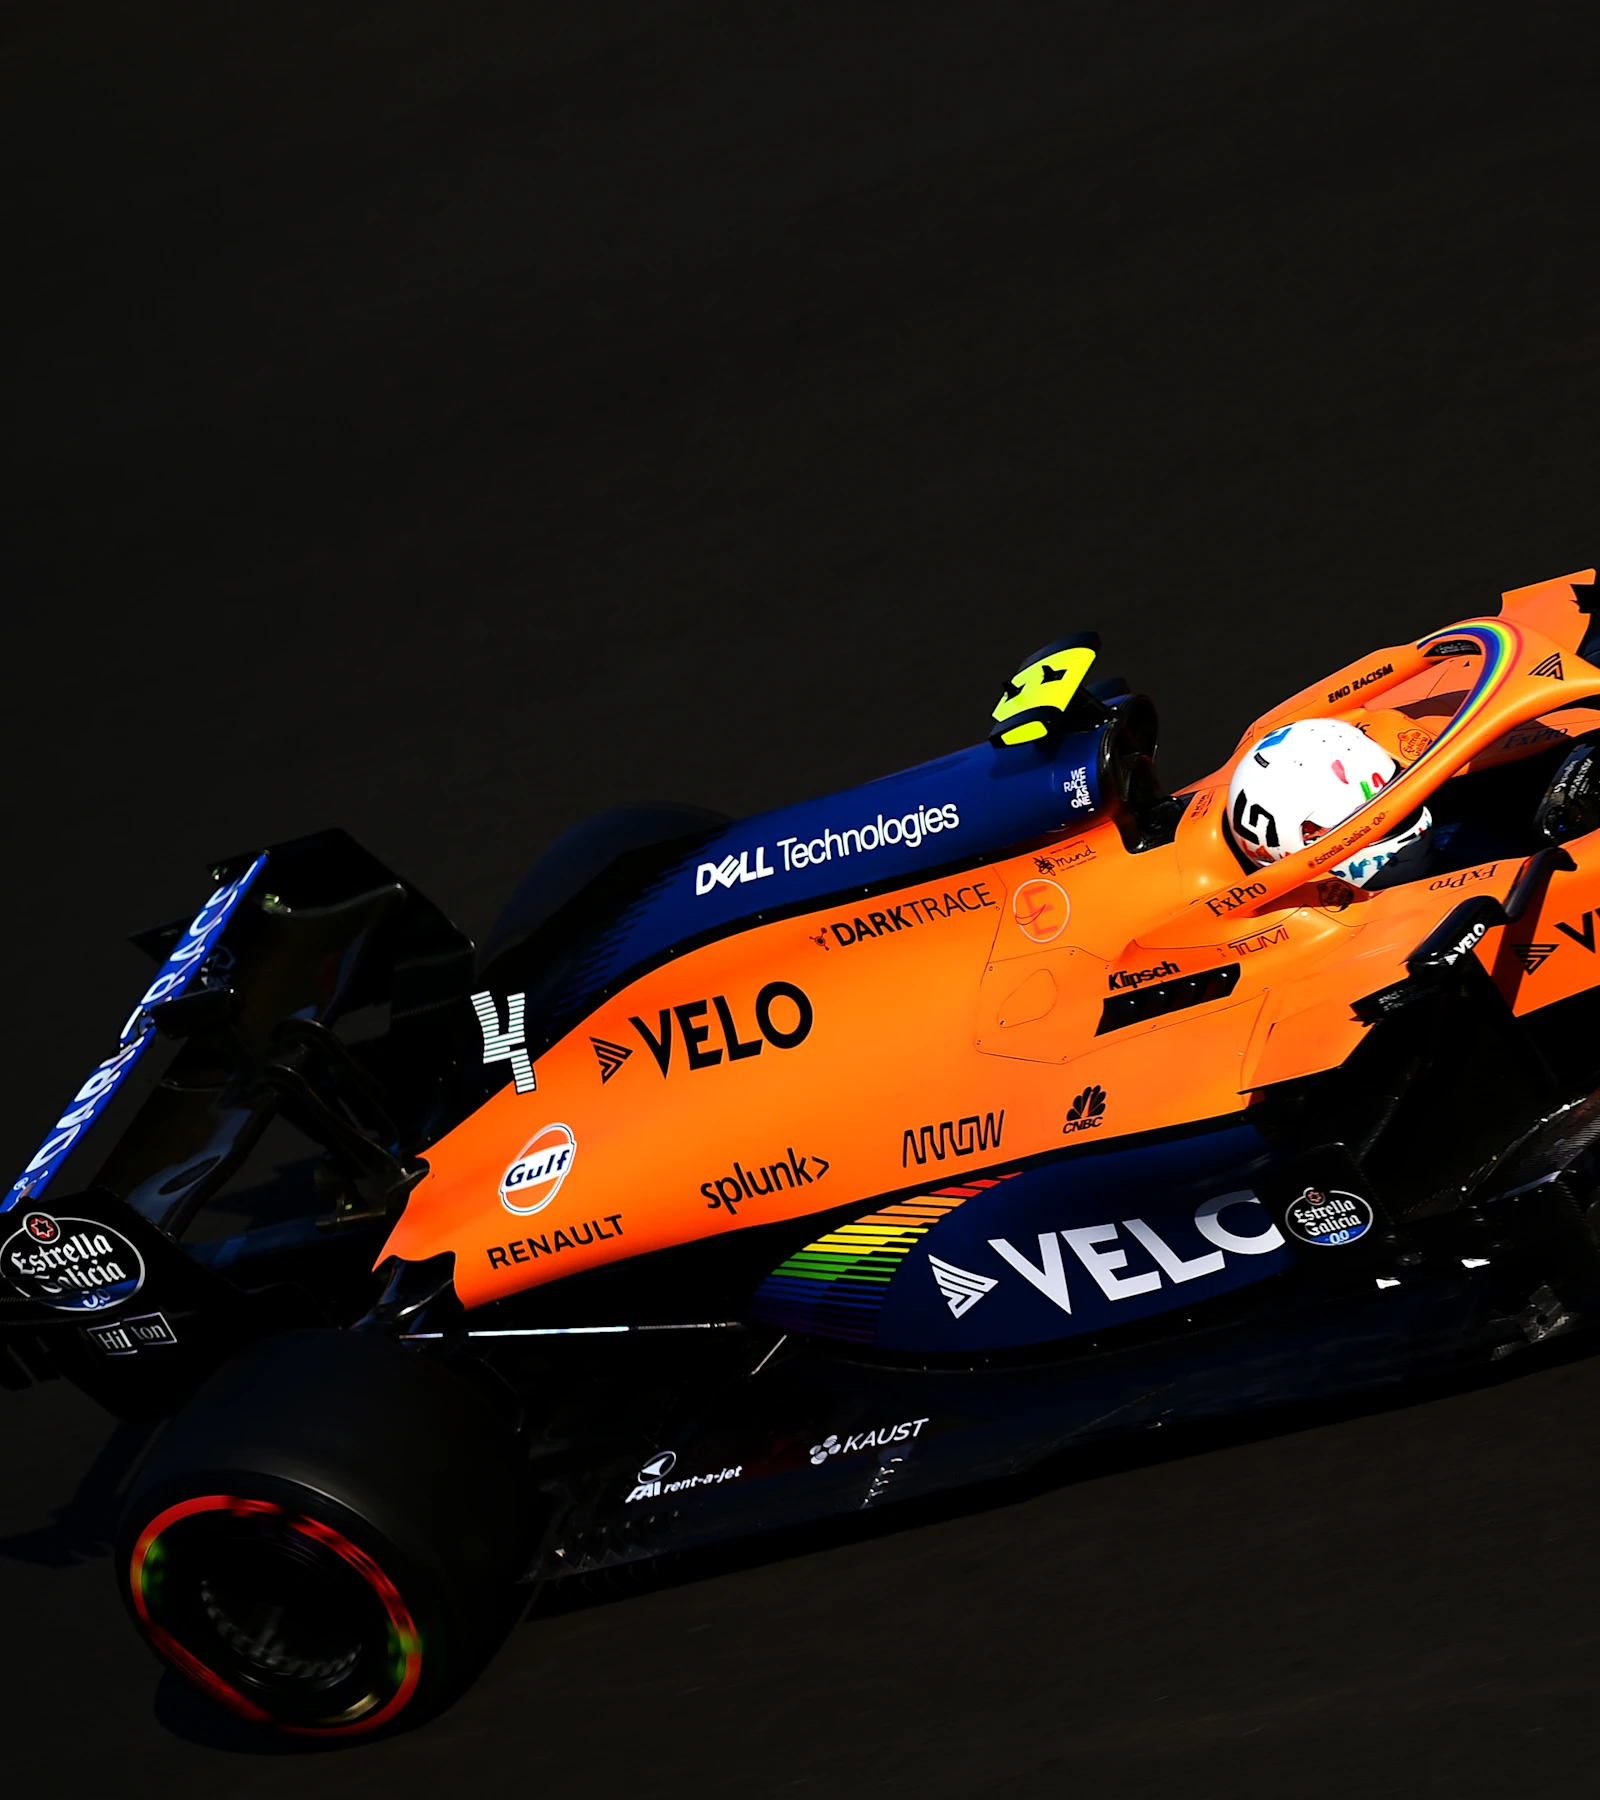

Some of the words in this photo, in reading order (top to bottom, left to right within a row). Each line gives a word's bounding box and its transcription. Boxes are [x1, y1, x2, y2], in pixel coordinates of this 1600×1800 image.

[1327, 685, 1351, 704] END
[1351, 663, 1394, 691] RACISM
[1503, 728, 1569, 749] FxPro
[1063, 779, 1088, 793] RACE
[1070, 766, 1087, 780] WE
[1070, 796, 1093, 809] ONE
[694, 845, 775, 898] DELL
[776, 803, 961, 873] Technologies
[1314, 844, 1344, 868] Estrella
[1430, 864, 1498, 892] FxPro
[830, 881, 997, 948] DARKTRACE
[1205, 881, 1267, 918] FxPro
[1228, 924, 1289, 956] TUMI
[1453, 923, 1486, 955] VELO
[1107, 960, 1181, 992] Klipsch
[470, 990, 537, 1094] 4
[628, 980, 814, 1080] VELO
[1062, 1116, 1104, 1135] CNBC
[503, 1147, 571, 1188] Gulf
[1293, 1199, 1356, 1224] Estrella
[1304, 1213, 1362, 1236] Galicia
[10, 1232, 114, 1276] Estrella
[487, 1214, 626, 1271] RENAULT
[96, 1323, 168, 1350] Hilton
[842, 1417, 930, 1454] KAUST
[662, 1465, 744, 1495] rent-a-jet
